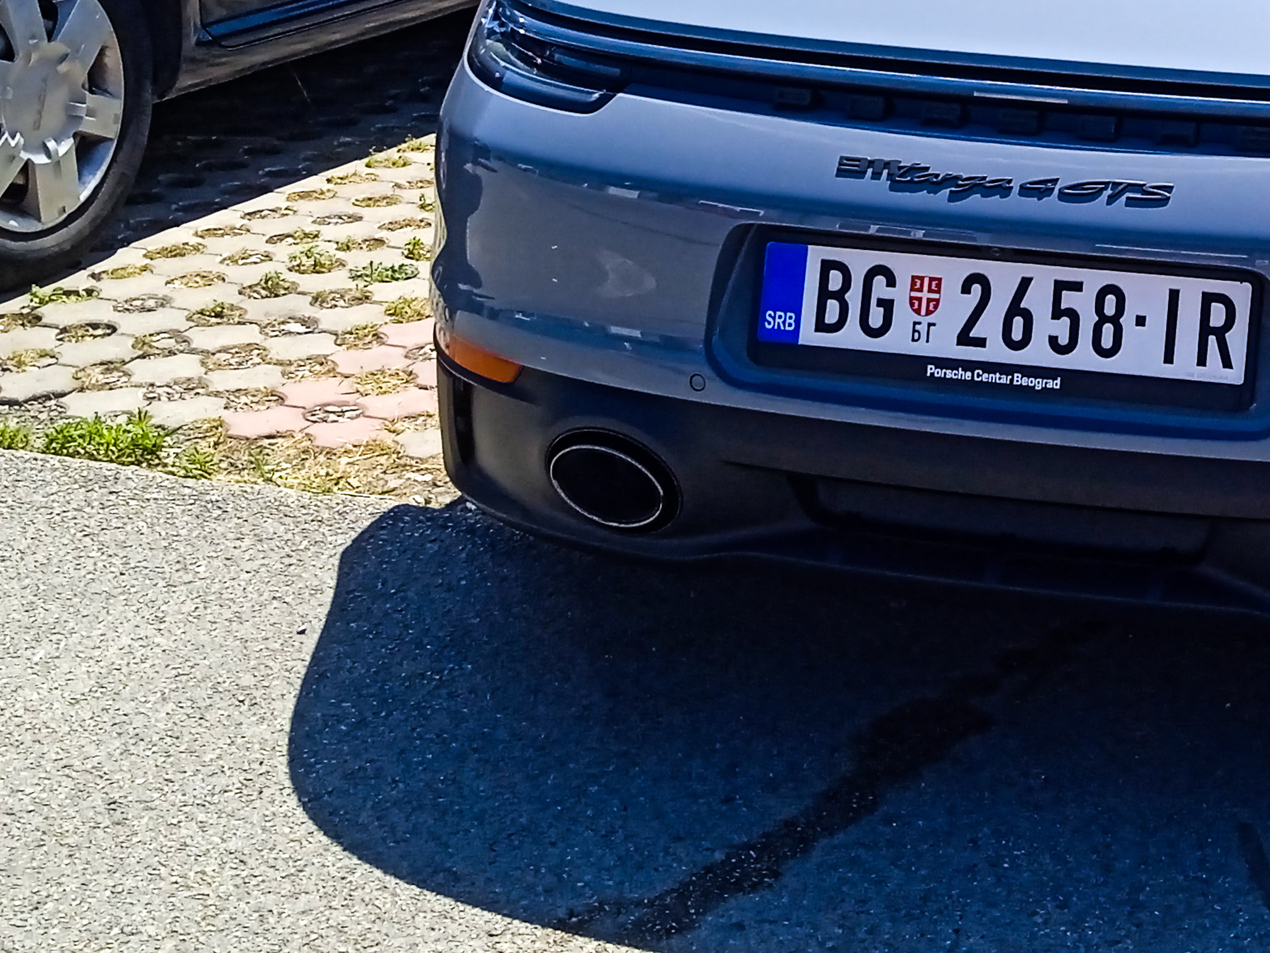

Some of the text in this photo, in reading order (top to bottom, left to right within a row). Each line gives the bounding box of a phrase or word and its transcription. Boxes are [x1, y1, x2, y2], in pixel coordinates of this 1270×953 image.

[1060, 179, 1174, 204] GTS
[814, 258, 897, 339] BG
[764, 310, 795, 331] SRB
[926, 364, 1061, 390] Porsche Centar Beograd
